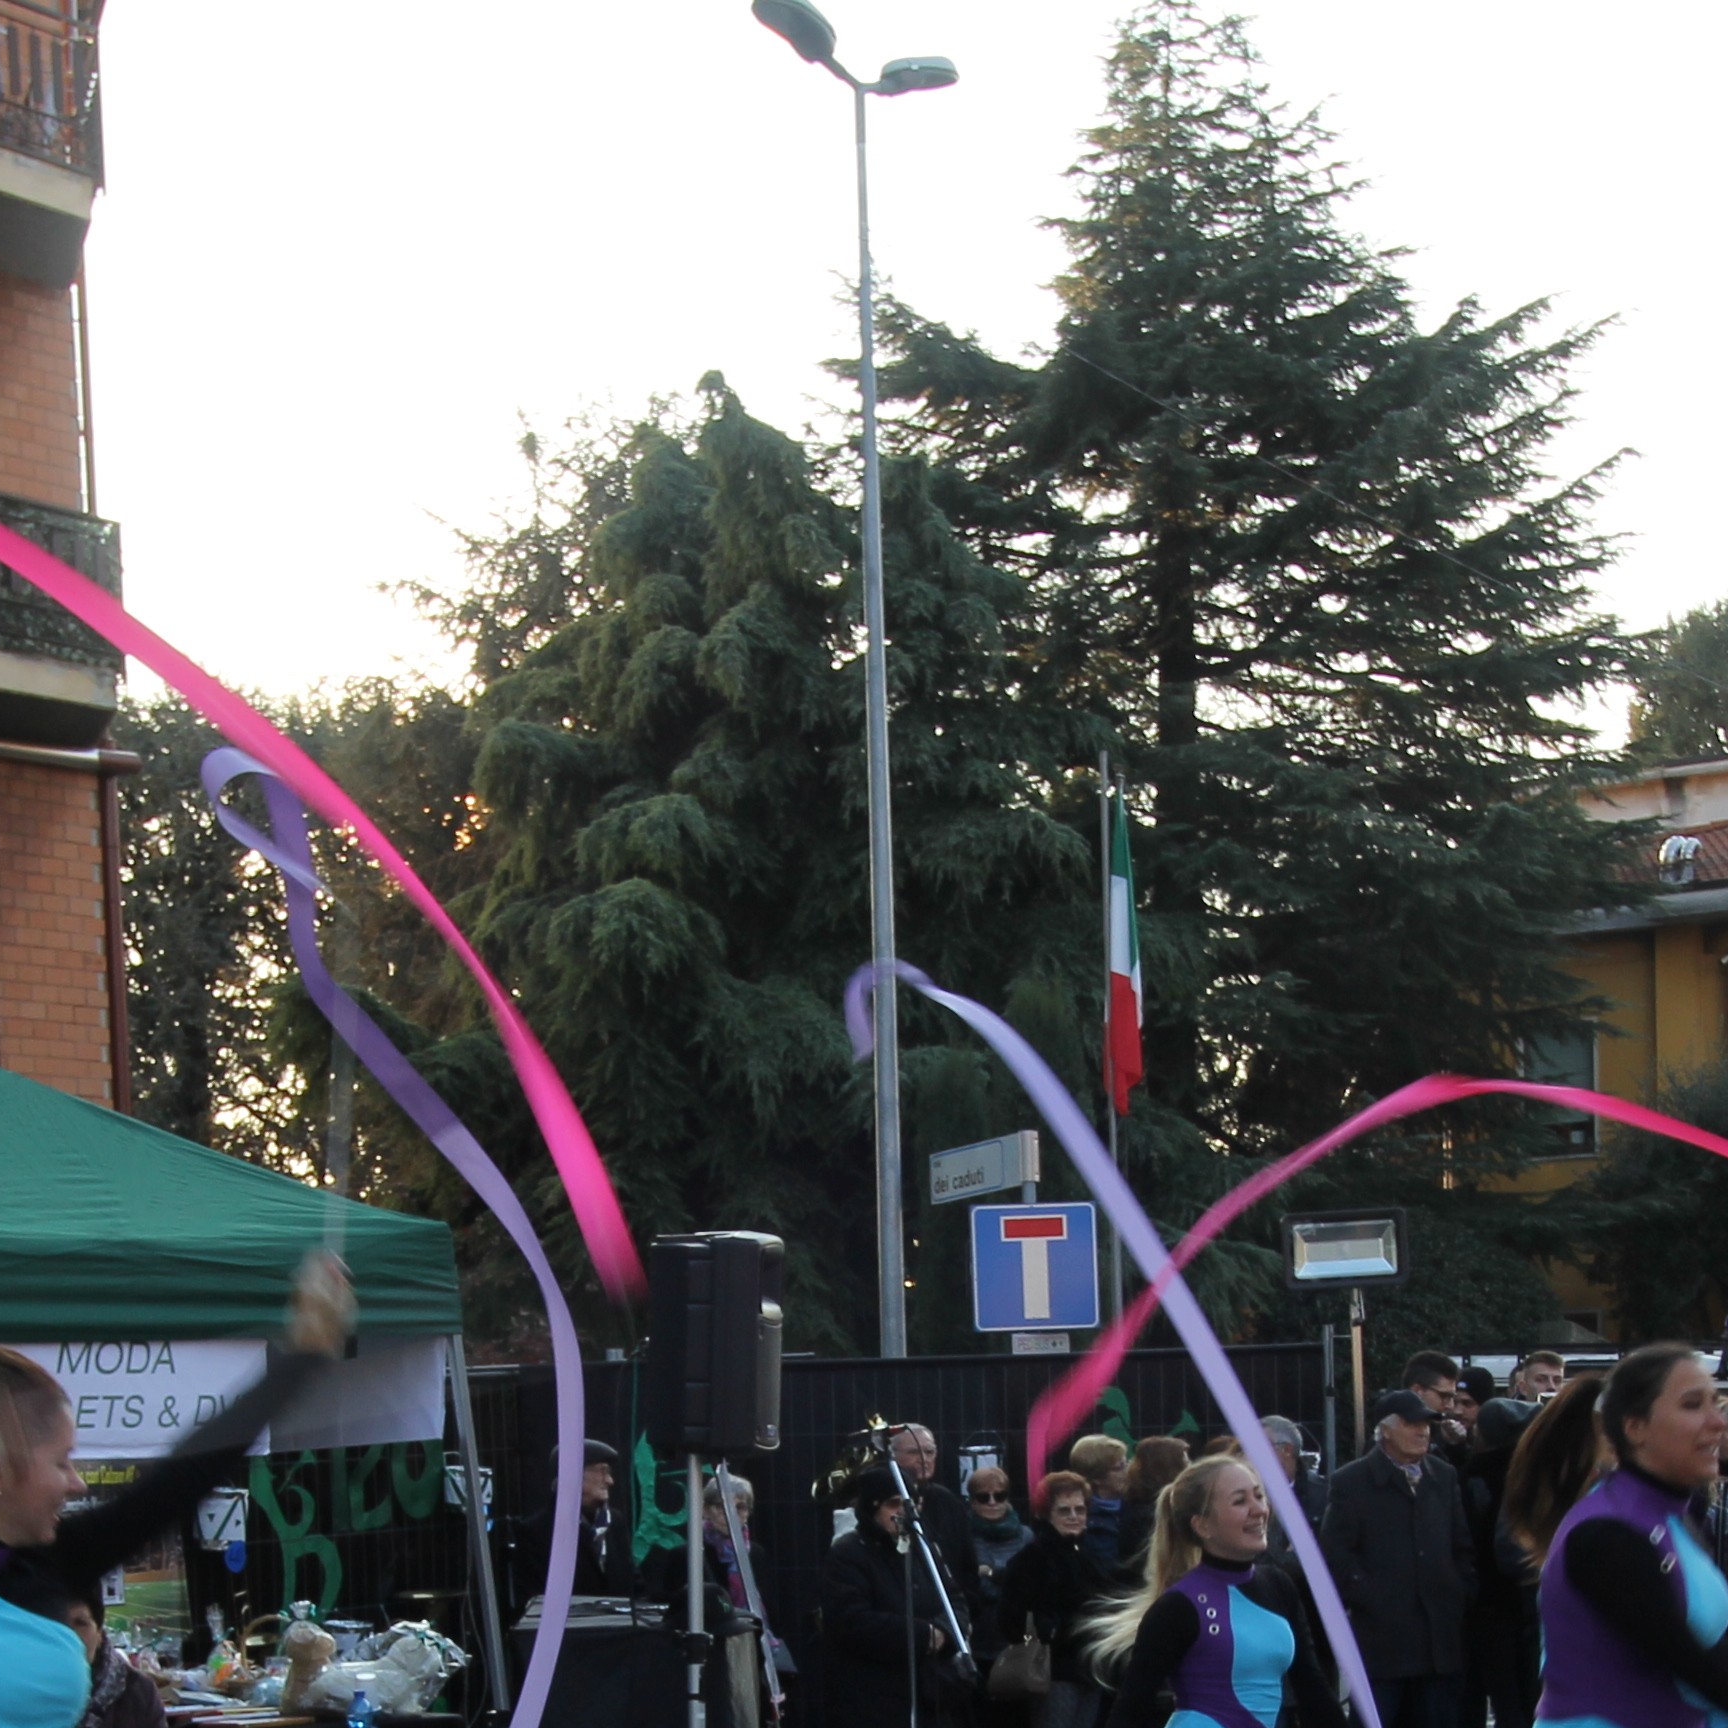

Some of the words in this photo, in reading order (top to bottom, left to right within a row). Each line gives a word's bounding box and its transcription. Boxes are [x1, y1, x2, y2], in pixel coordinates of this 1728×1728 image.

[935, 1175, 949, 1194] dei
[953, 1167, 984, 1190] caduti
[55, 1340, 176, 1375] MODA
[157, 1394, 181, 1428] &
